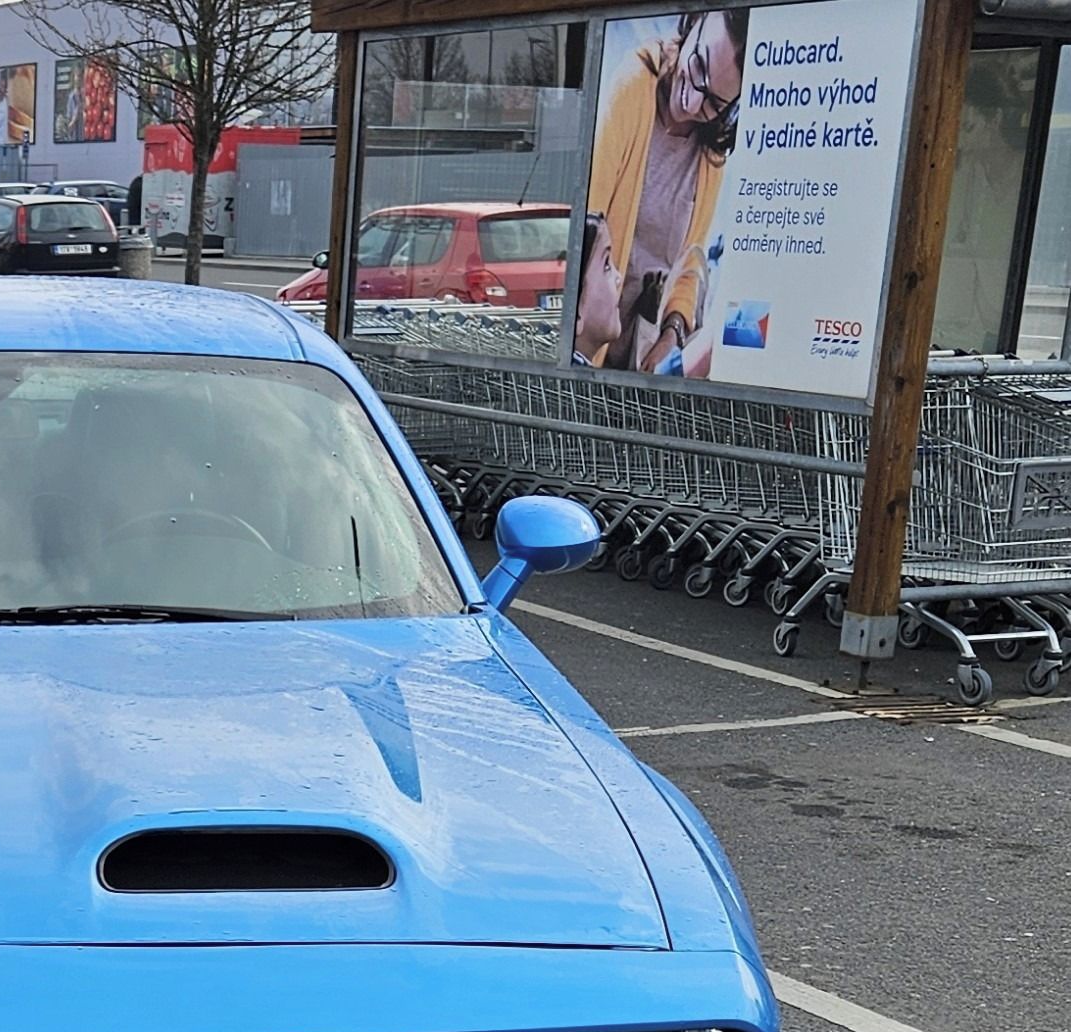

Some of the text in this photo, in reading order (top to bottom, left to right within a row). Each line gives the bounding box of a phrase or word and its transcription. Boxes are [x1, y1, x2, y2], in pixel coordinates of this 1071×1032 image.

[753, 35, 843, 67] Clubcard.
[749, 76, 878, 112] Mnoho výhod
[745, 117, 878, 155] v jediné kartě.
[738, 178, 838, 201] Zaregistrujte se
[735, 205, 826, 230] a čerpejte své
[732, 233, 826, 258] odměny ihned.
[814, 319, 862, 338] TESCO
